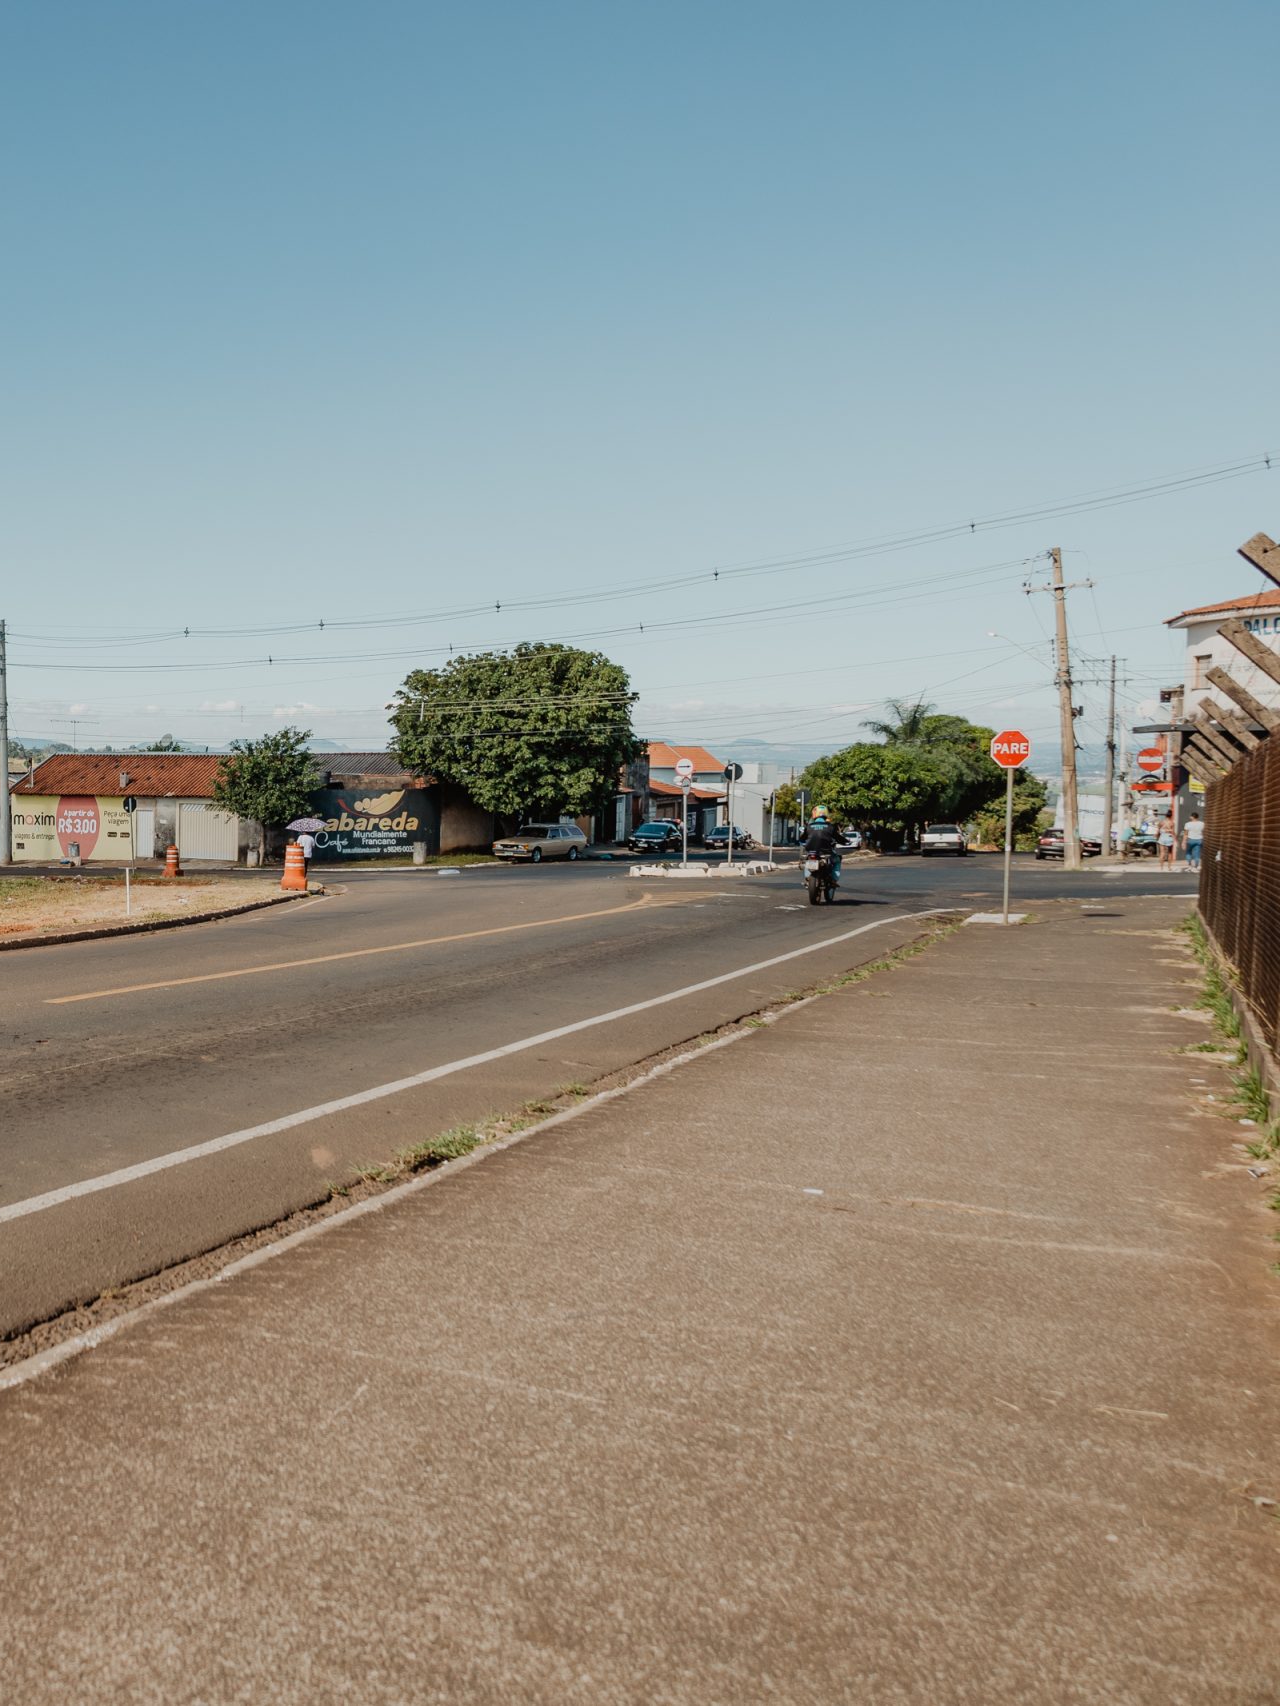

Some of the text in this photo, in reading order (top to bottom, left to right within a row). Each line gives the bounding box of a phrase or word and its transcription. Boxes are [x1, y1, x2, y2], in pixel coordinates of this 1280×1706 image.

[994, 743, 1028, 754] PARE
[14, 812, 55, 826] maxim
[58, 818, 97, 835] R$ 3,00
[314, 812, 418, 831] abareda
[315, 831, 348, 852] Café
[353, 830, 407, 838] Mundialmente
